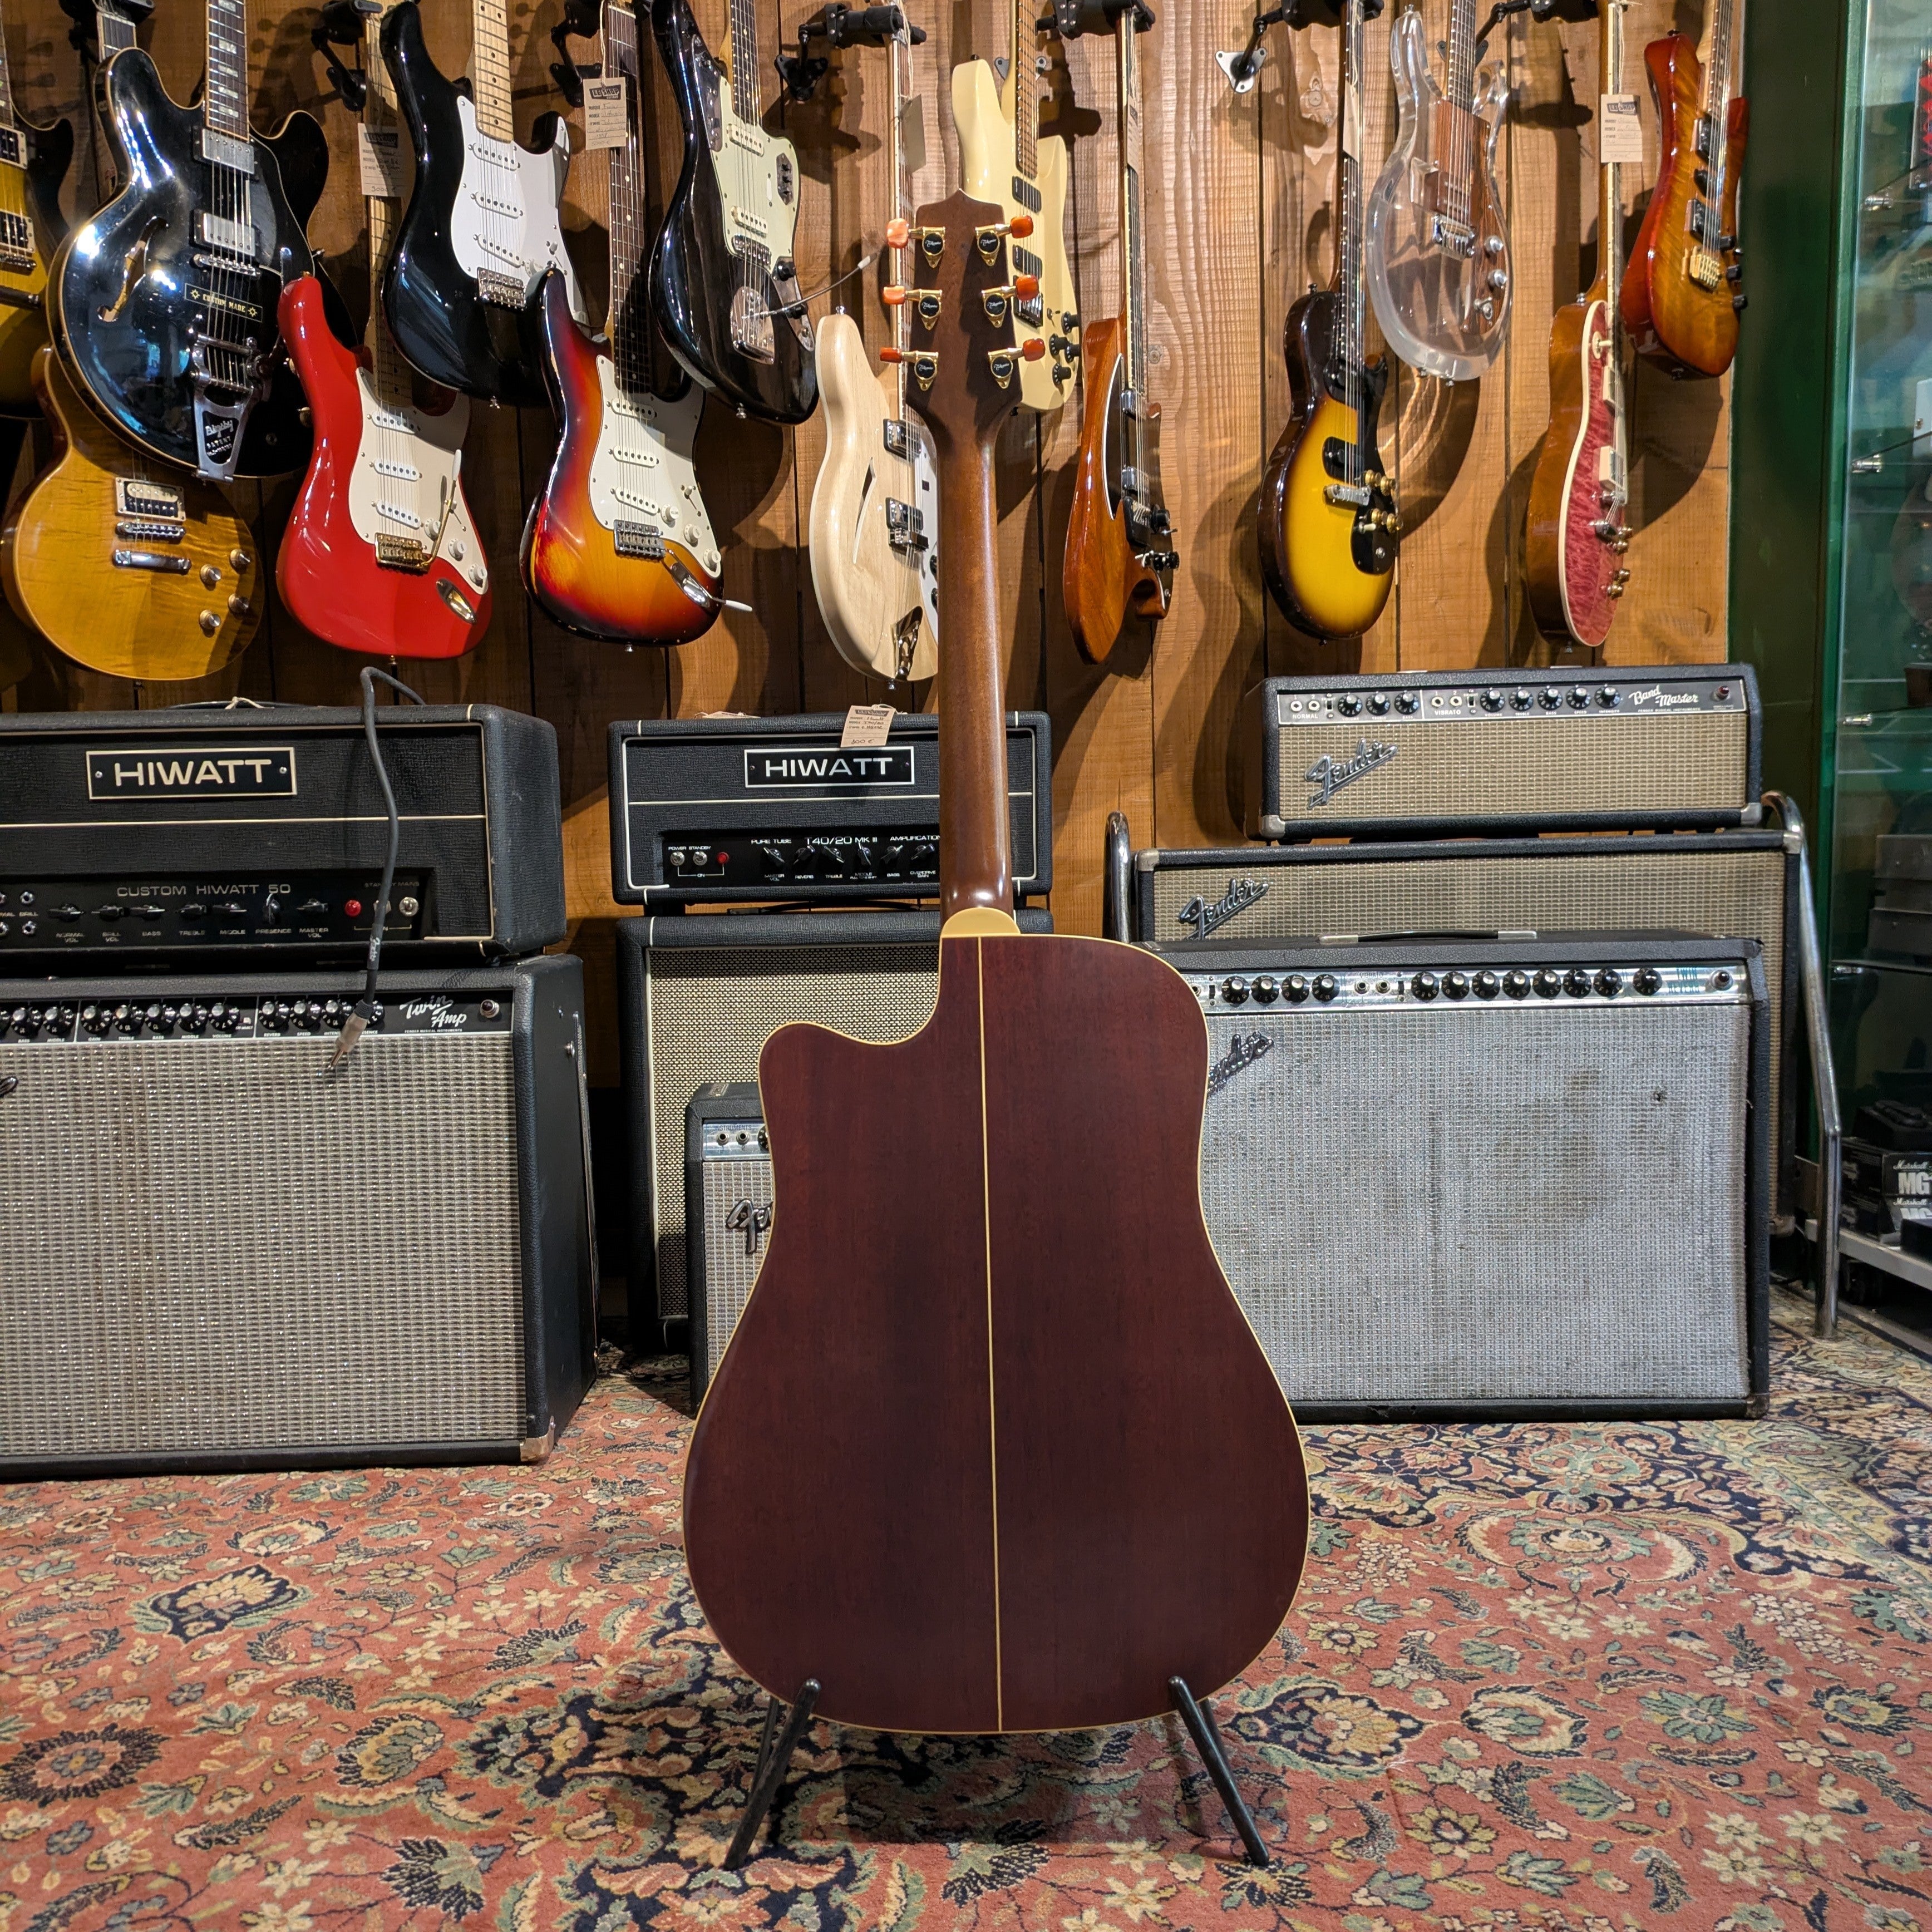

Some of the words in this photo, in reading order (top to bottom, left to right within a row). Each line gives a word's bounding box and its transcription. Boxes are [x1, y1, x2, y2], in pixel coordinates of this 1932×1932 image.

[601, 88, 620, 96] SHOP
[203, 293, 226, 307] CUSTOM
[229, 301, 246, 313] MADE
[205, 420, 234, 438] Bigsby
[206, 436, 231, 448] PATENT
[1629, 683, 1662, 706] Band
[1655, 693, 1699, 707] Master
[114, 759, 272, 787] HIWATT
[765, 757, 893, 777] HIWATT
[1304, 737, 1398, 810] Fender
[807, 836, 852, 845] T40/20
[116, 885, 187, 897] CUSTOM
[196, 884, 260, 895] HIWATT
[268, 883, 291, 894] 50
[1177, 878, 1271, 940] Fender
[399, 994, 454, 1019] Twin
[431, 1011, 467, 1028] Amp
[1893, 1159, 1930, 1170] Marshall
[1893, 1197, 1928, 1206] Marshall
